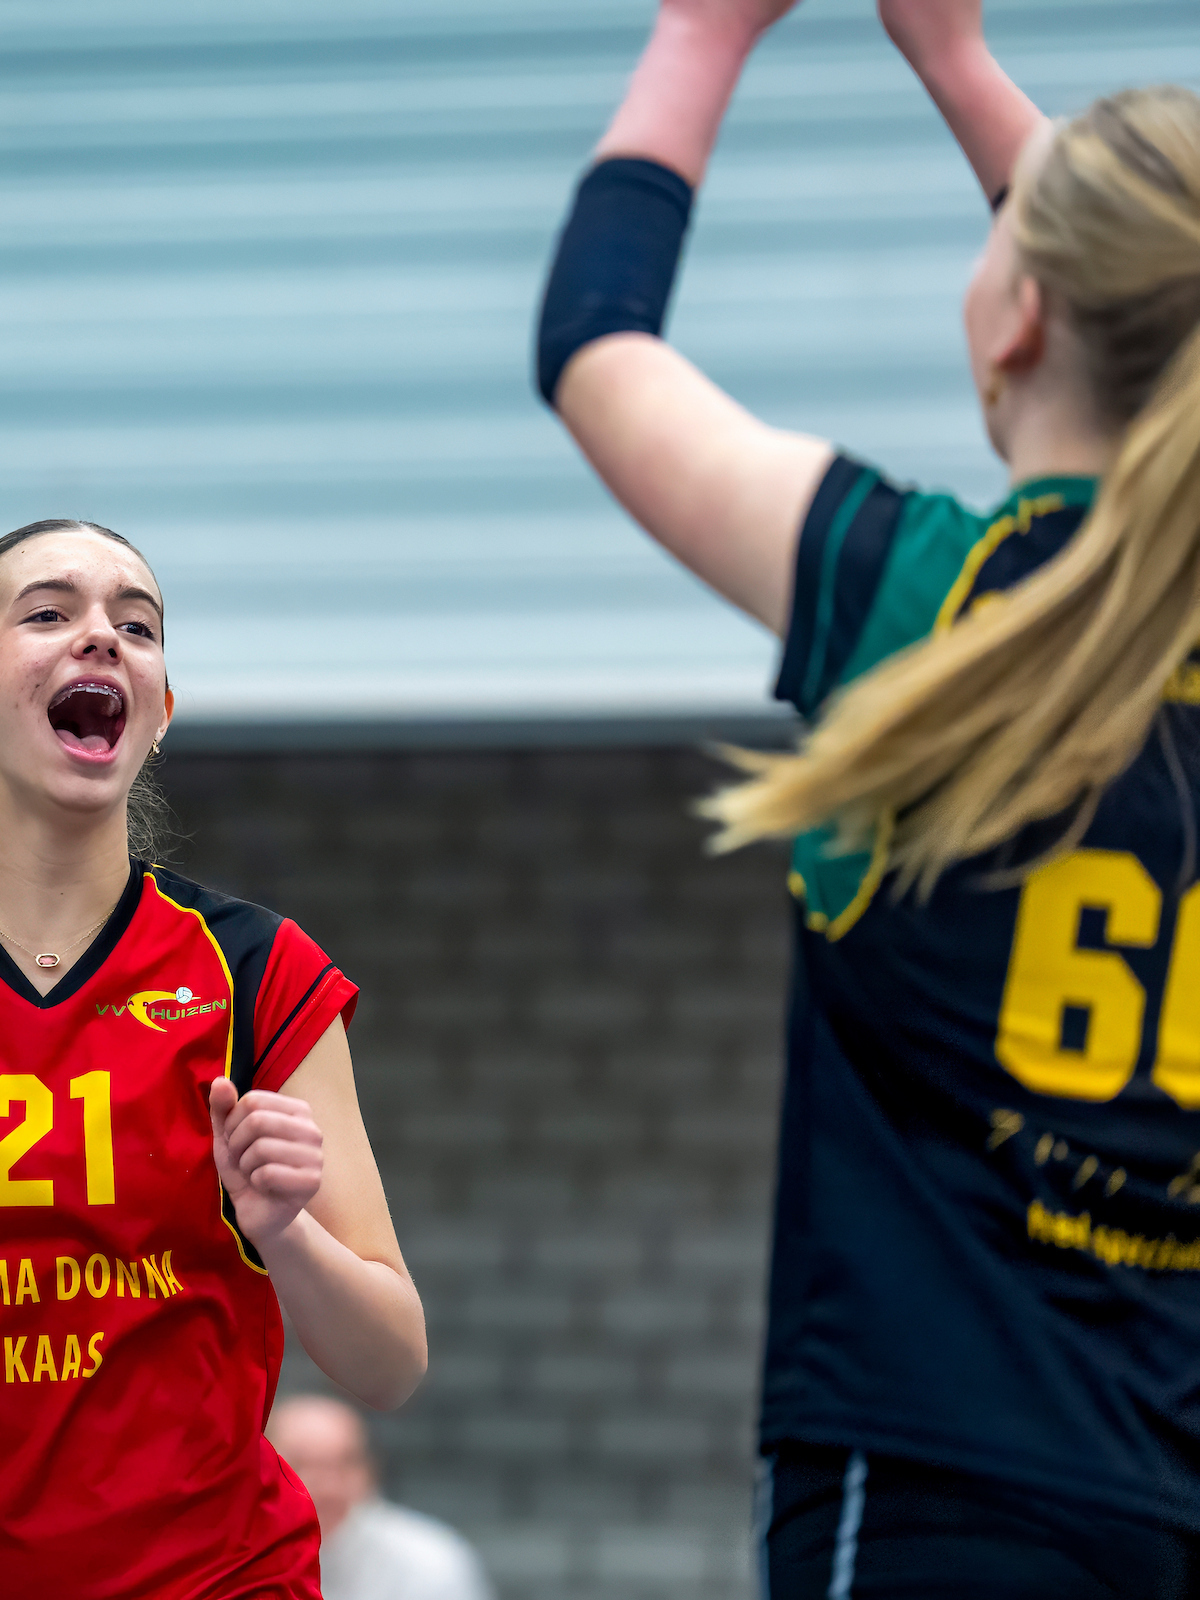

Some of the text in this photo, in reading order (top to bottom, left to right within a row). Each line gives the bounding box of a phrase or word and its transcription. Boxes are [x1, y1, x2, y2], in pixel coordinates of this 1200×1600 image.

[96, 999, 227, 1021] VV HUIZEN
[56, 1250, 184, 1300] DONNA
[3, 1332, 104, 1383] KAAS
